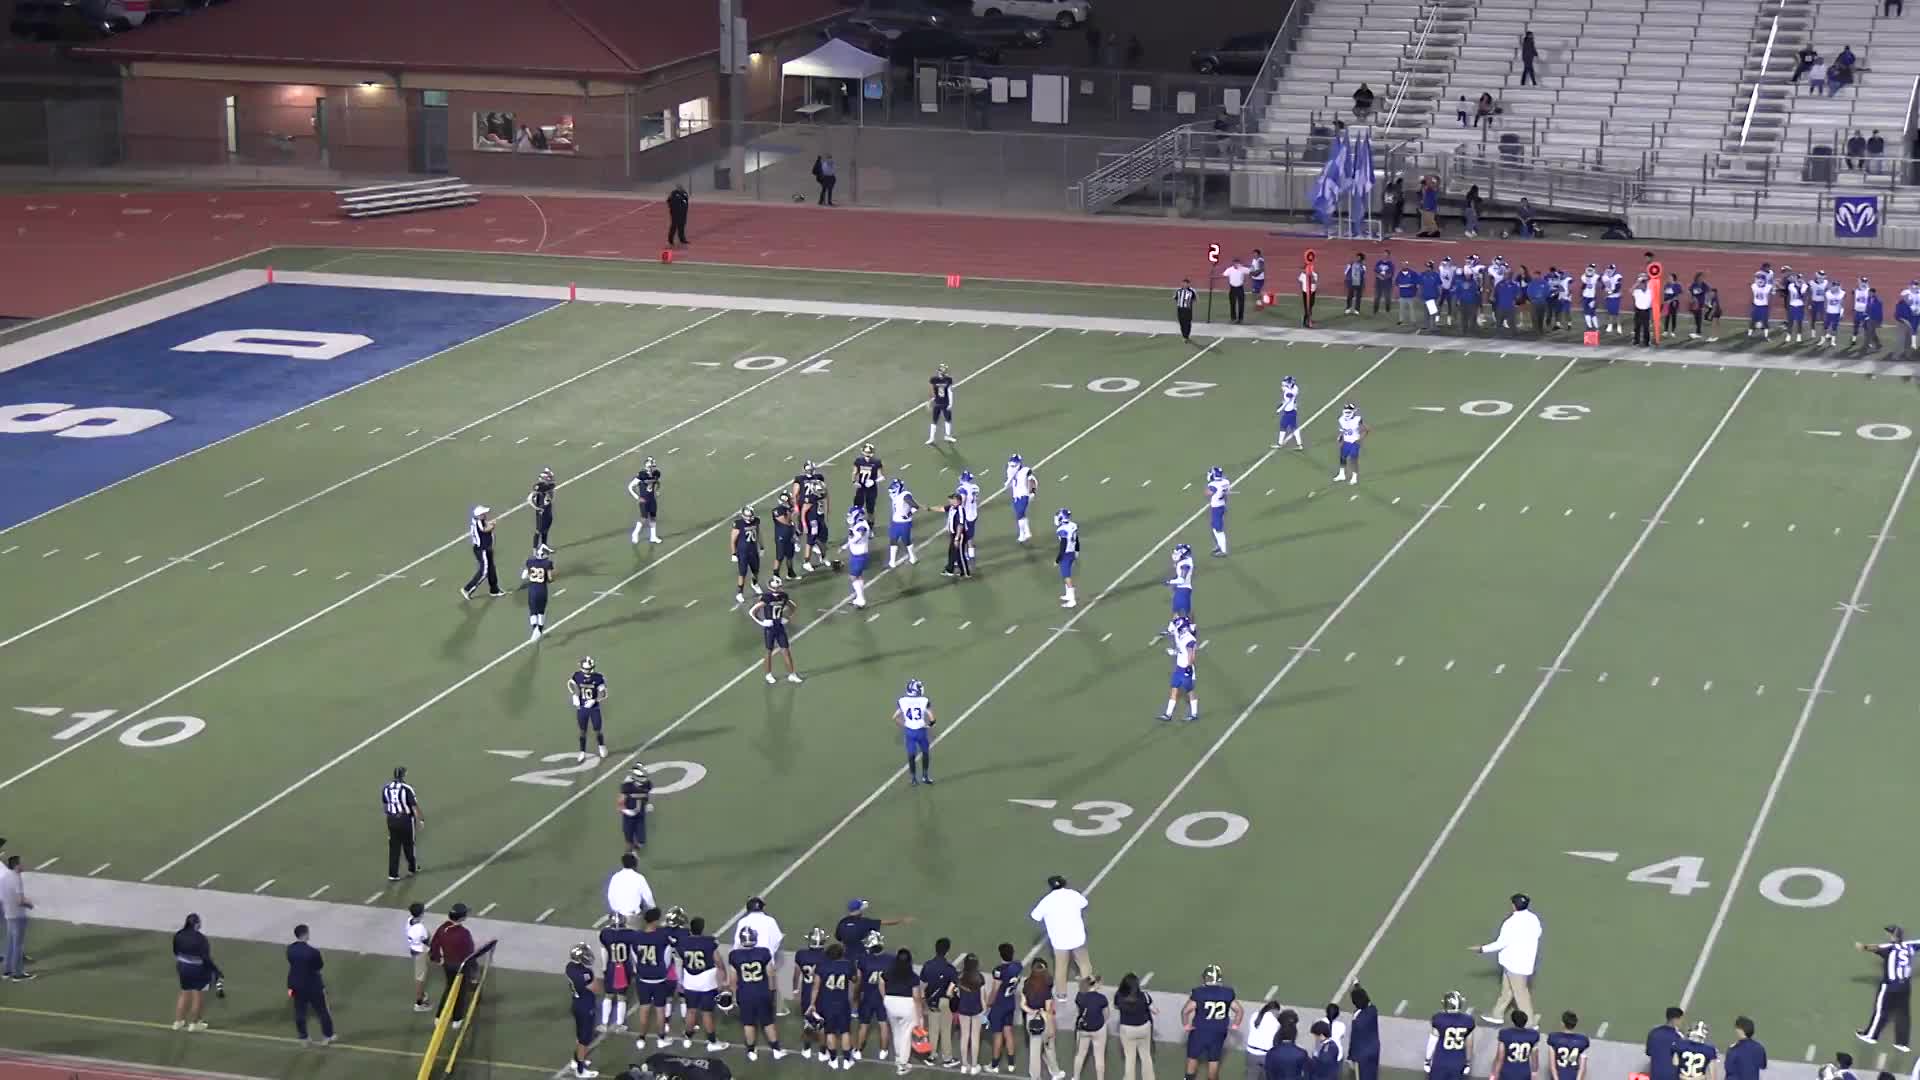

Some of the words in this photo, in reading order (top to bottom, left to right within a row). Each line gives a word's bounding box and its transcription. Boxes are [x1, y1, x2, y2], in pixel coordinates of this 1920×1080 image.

[905, 707, 922, 721] 43
[610, 943, 627, 962] 10
[637, 945, 658, 966] 74
[683, 950, 706, 970] 76
[740, 960, 763, 982] 62
[825, 973, 846, 990] 44
[1203, 1000, 1227, 1020] 72
[1443, 1026, 1468, 1050] 65
[1507, 1041, 1532, 1063] 30
[1556, 1046, 1580, 1068] 34
[1679, 1051, 1706, 1078] 32
